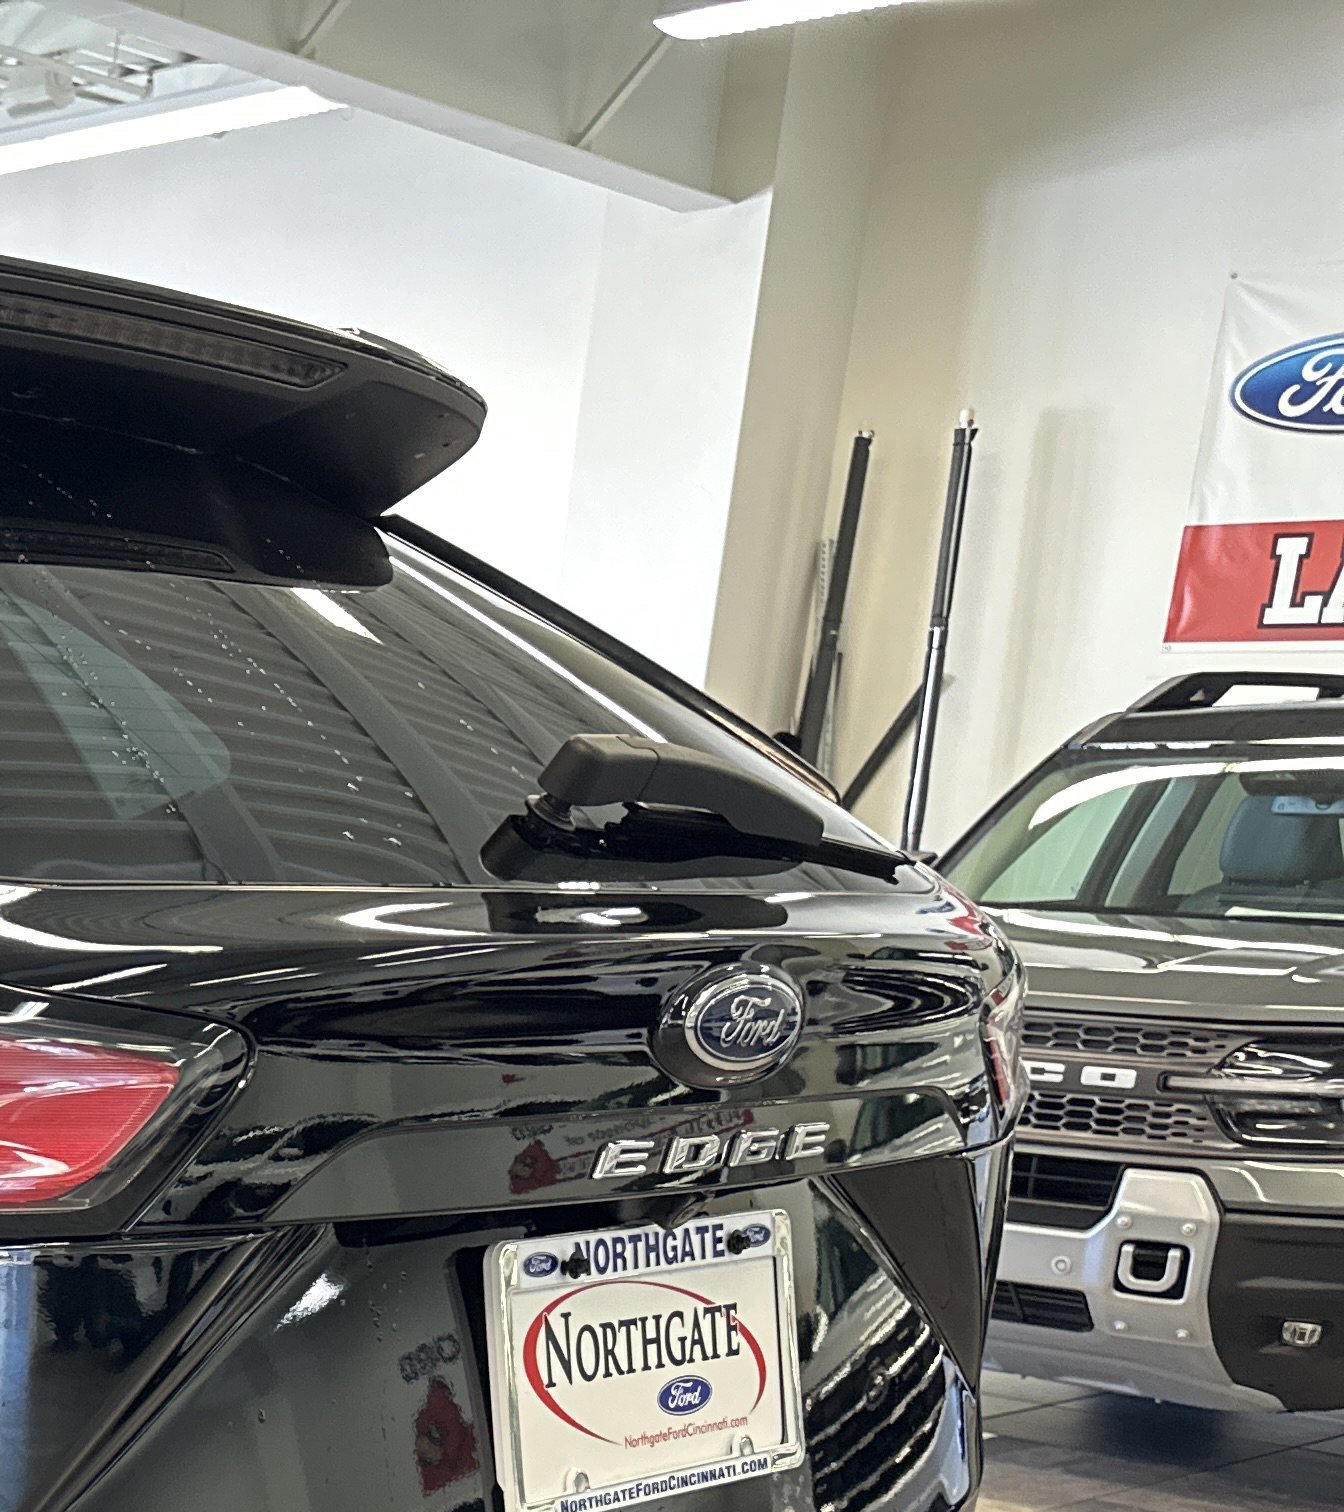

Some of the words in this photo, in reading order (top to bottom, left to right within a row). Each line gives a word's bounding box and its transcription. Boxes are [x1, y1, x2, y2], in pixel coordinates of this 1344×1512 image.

[719, 994, 785, 1048] Ford
[589, 1121, 831, 1180] EDGE
[529, 1255, 552, 1273] Ford
[575, 1223, 725, 1276] NORTHGATE
[543, 1302, 741, 1389] NORTHGATE
[667, 1381, 702, 1409] Ford
[624, 1416, 748, 1449] NorthgateFordCincinnati.com
